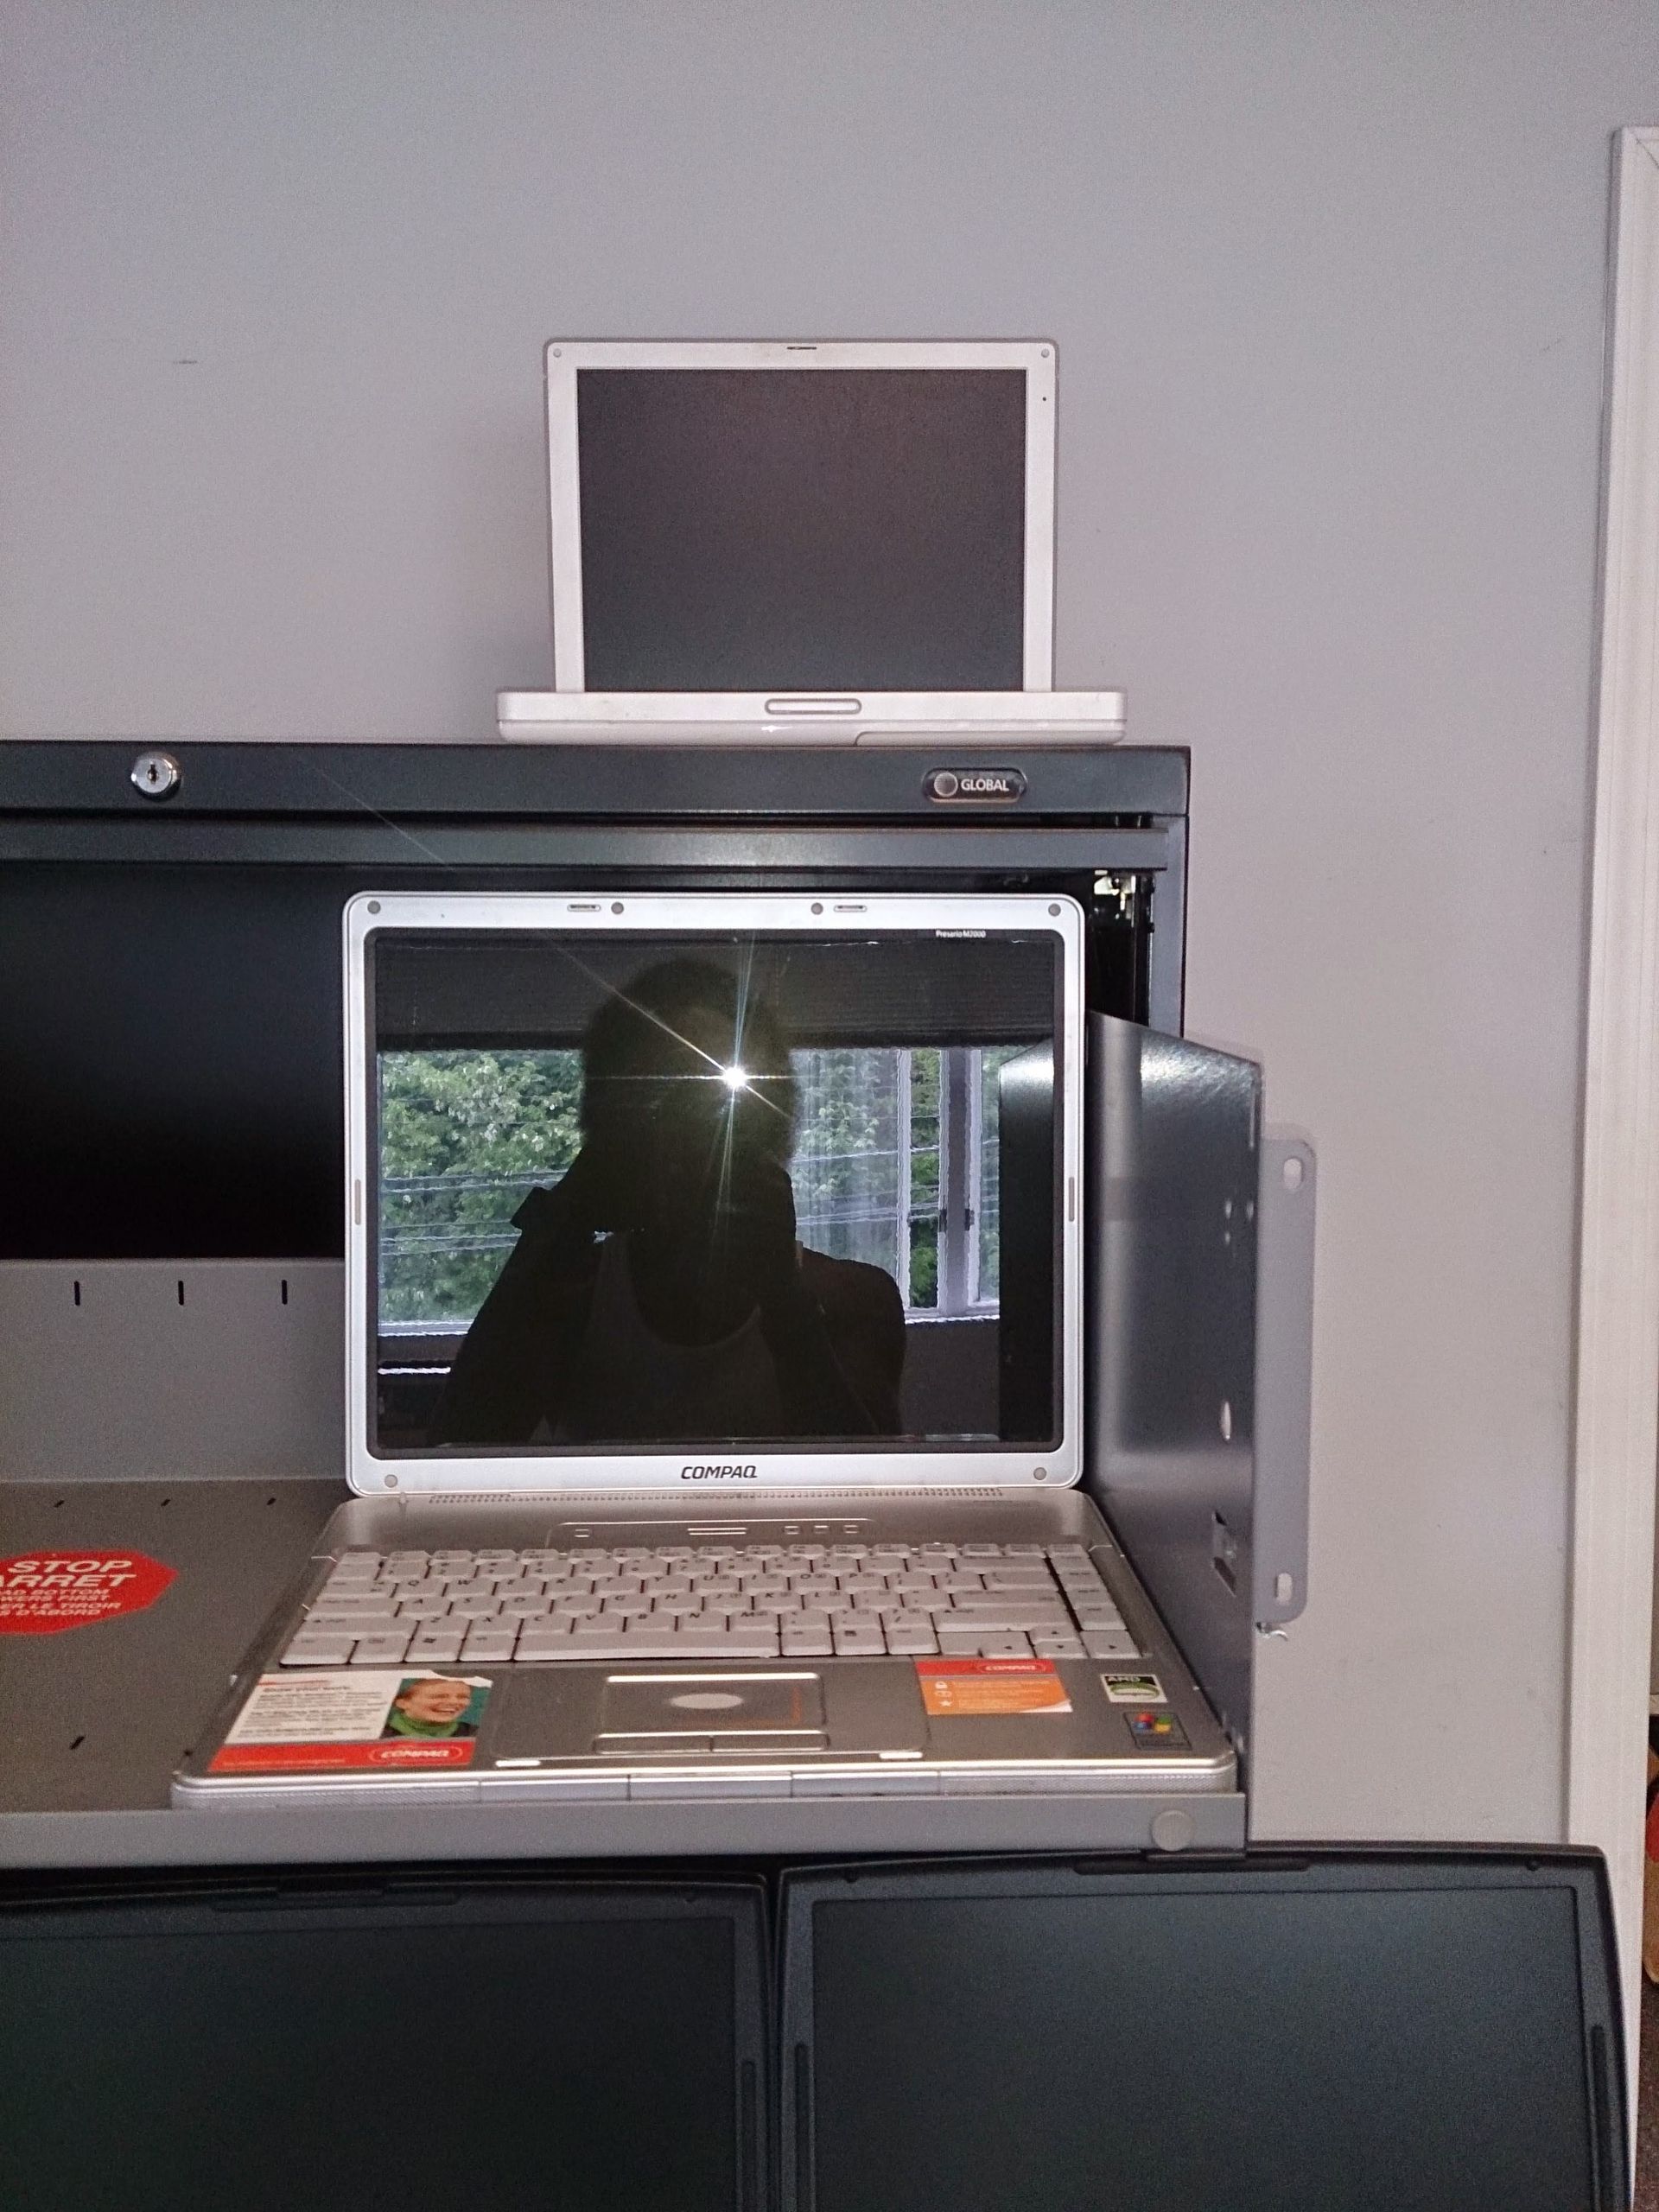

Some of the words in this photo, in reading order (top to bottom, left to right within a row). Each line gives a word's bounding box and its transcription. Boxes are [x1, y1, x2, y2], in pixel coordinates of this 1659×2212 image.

[961, 779, 1010, 791] GLOBAL
[681, 1465, 758, 1479] COMPAQ
[8, 1560, 132, 1573] STOP
[0, 1574, 137, 1587] RRET
